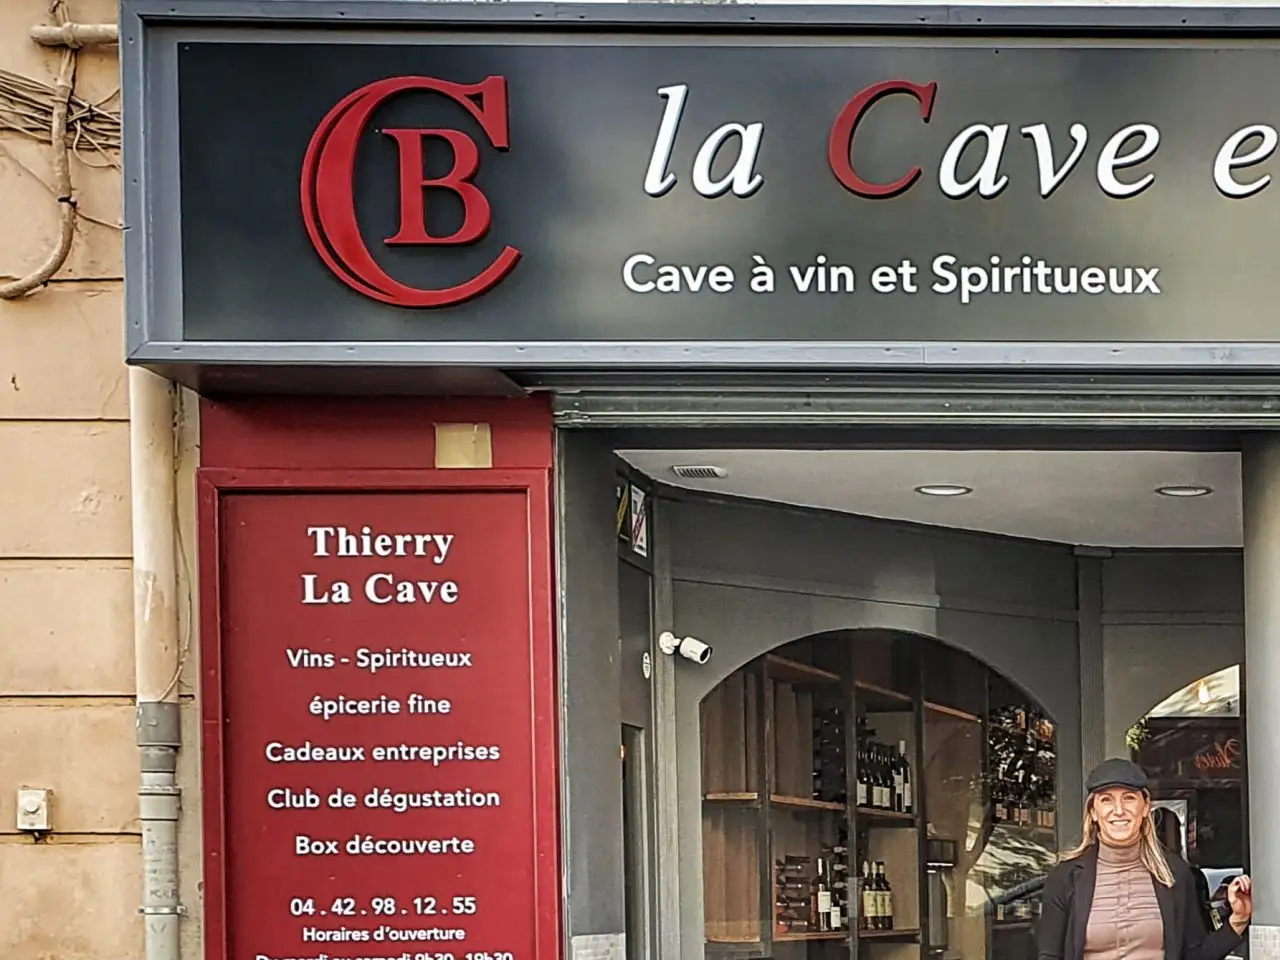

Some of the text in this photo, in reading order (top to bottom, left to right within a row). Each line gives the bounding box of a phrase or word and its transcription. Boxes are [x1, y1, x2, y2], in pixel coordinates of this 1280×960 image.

[642, 84, 765, 199] la
[827, 78, 1161, 199] Cave
[623, 252, 1161, 305] Cave à vin et Spiritueux
[306, 525, 455, 565] Thierry
[300, 572, 459, 605] La Cave
[286, 648, 335, 669] Vins
[356, 647, 474, 674] Spiritueux
[308, 692, 452, 722] épicerie fine
[265, 740, 502, 769] Cadeaux entreprises
[266, 785, 501, 814] Club de dégustation
[294, 832, 475, 856] Box découverte
[303, 925, 466, 943] Horaires d'ouverture
